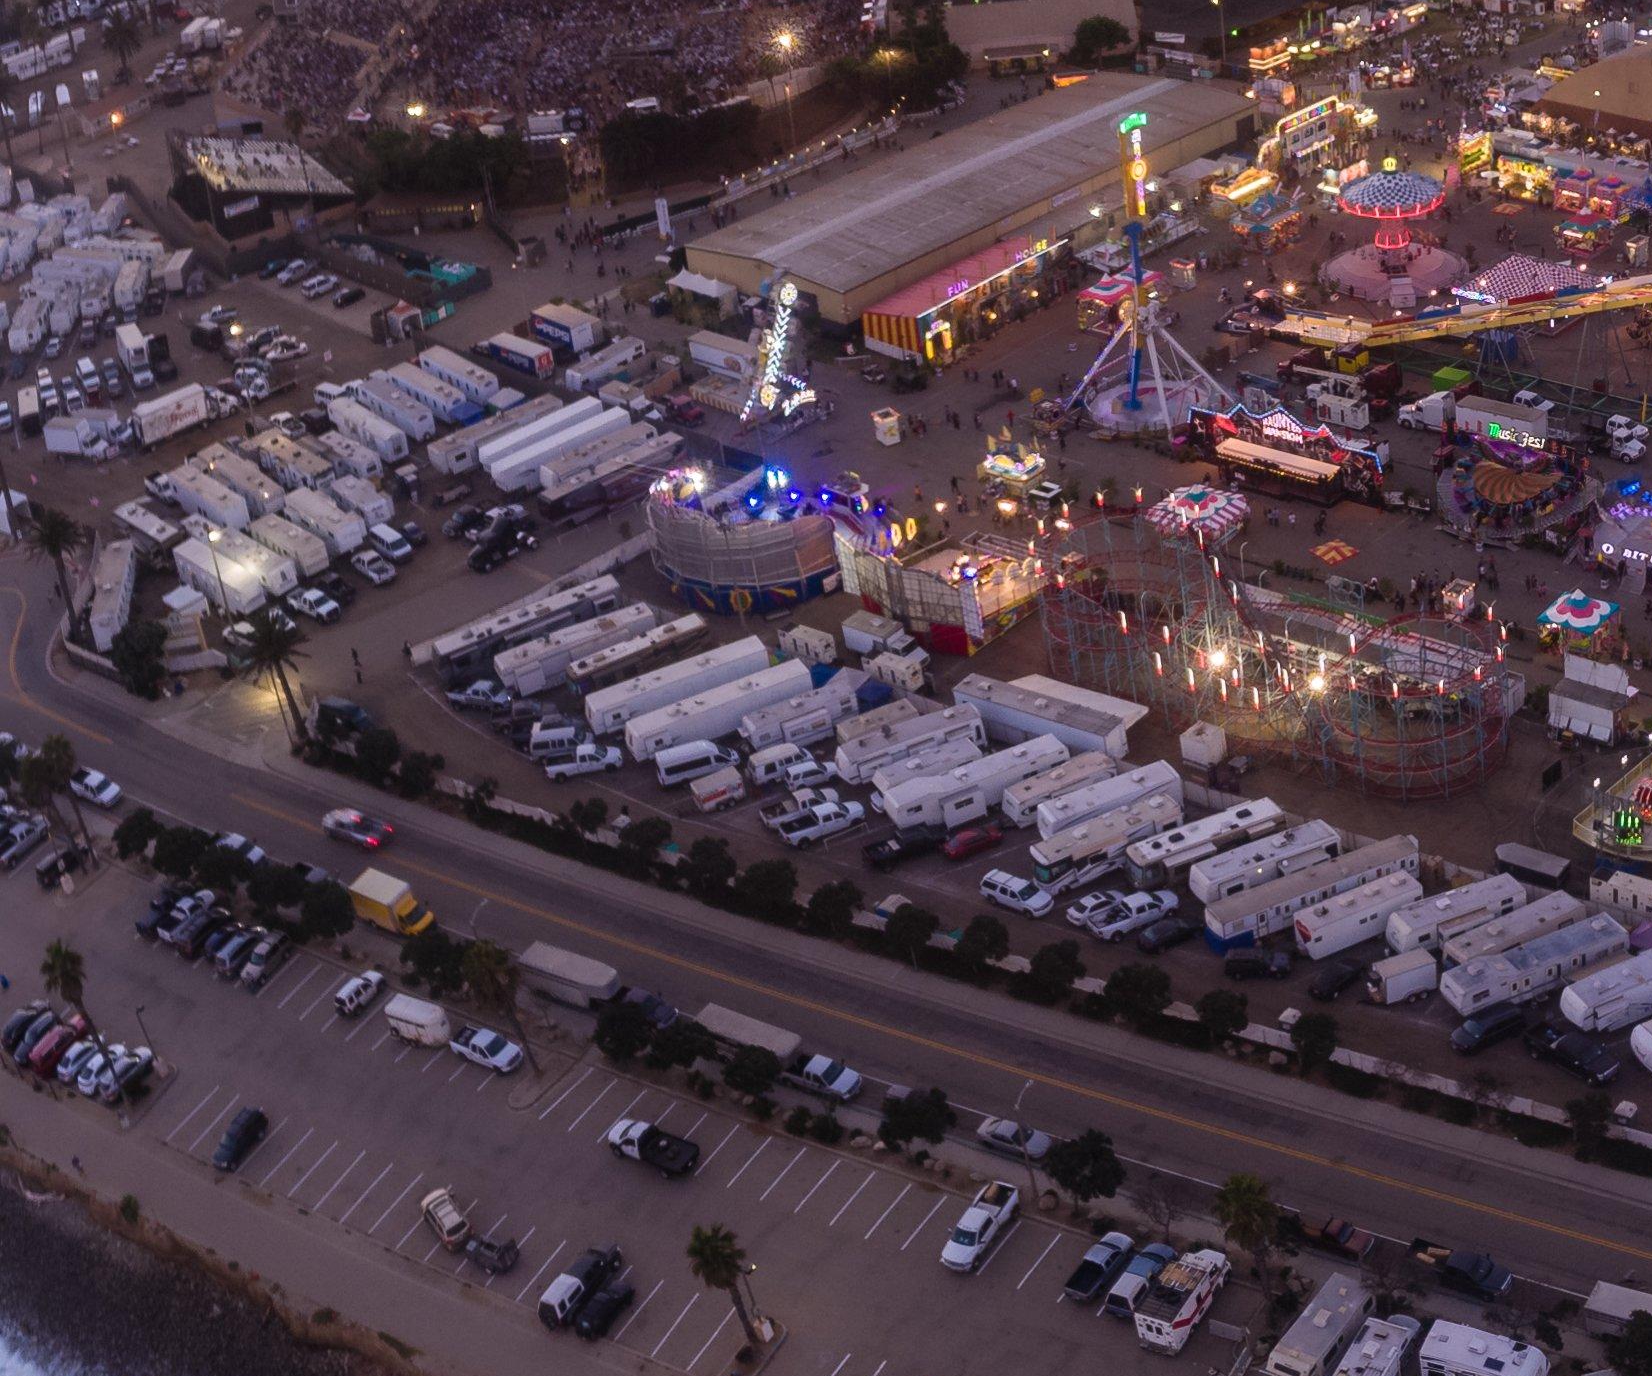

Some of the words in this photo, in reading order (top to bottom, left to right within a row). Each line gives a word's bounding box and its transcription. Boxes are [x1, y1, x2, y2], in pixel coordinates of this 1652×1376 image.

[947, 279, 969, 298] FUN
[1014, 239, 1048, 262] HOUSE
[1488, 422, 1519, 442] Music
